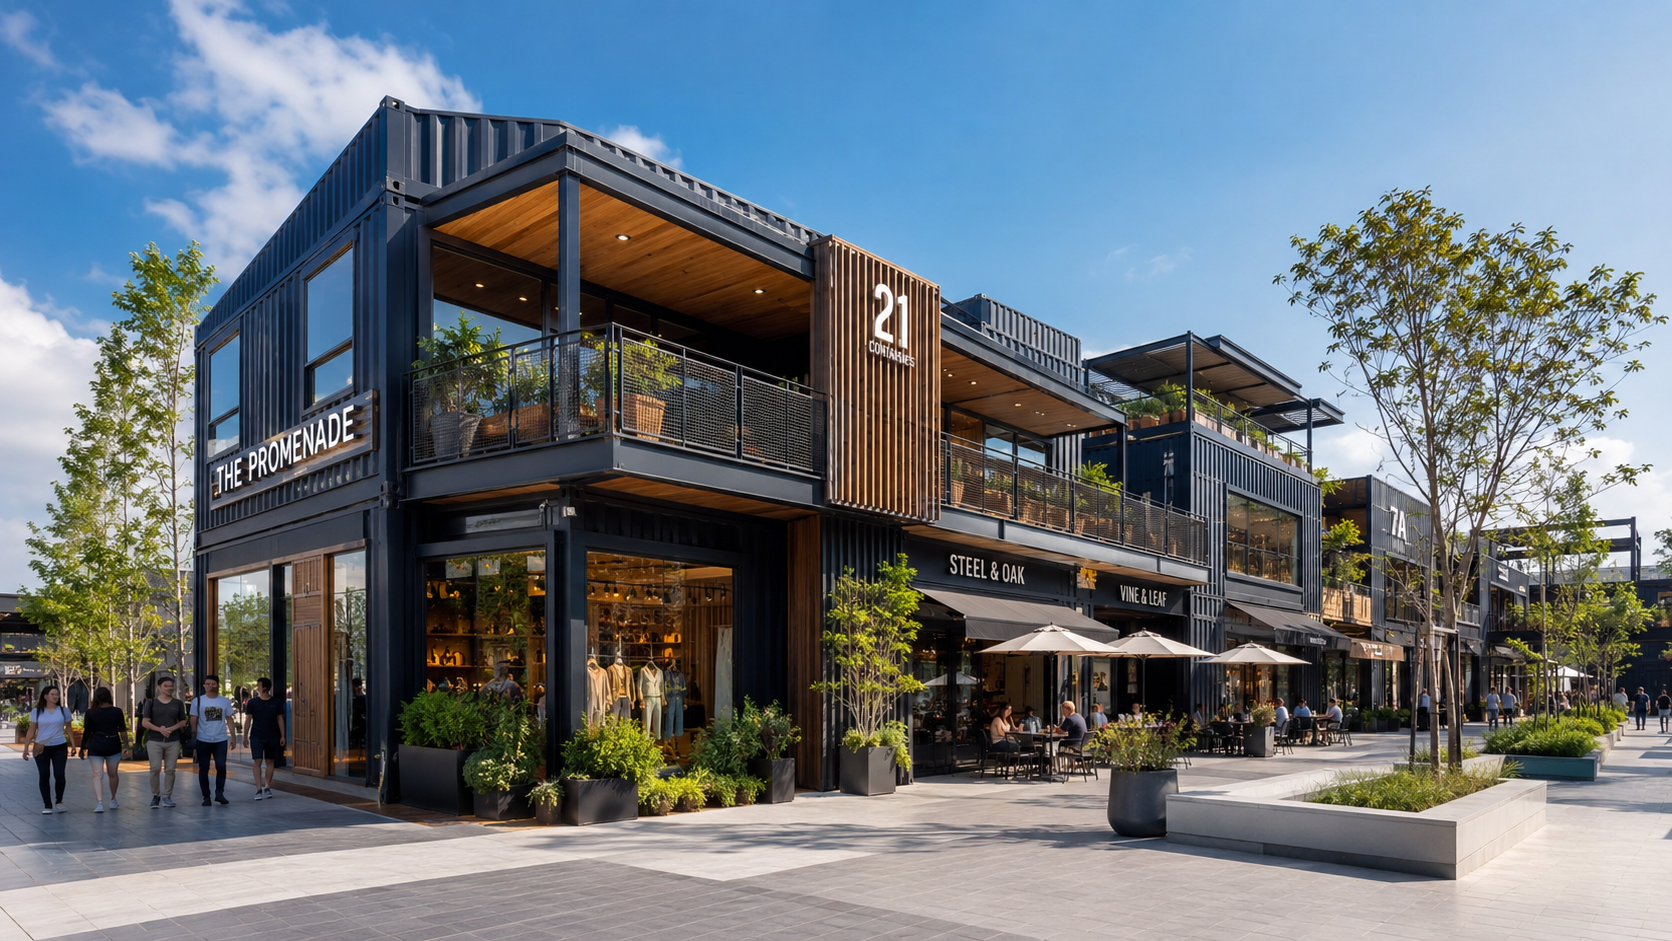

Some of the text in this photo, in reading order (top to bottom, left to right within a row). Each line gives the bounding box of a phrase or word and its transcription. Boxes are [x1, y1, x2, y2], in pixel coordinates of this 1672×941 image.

[874, 283, 908, 350] 21
[216, 404, 355, 494] THE PROMENADE
[1390, 505, 1407, 541] 7A
[949, 553, 1025, 585] STEEL & OAK
[1120, 584, 1167, 607] VINE & LEAF
